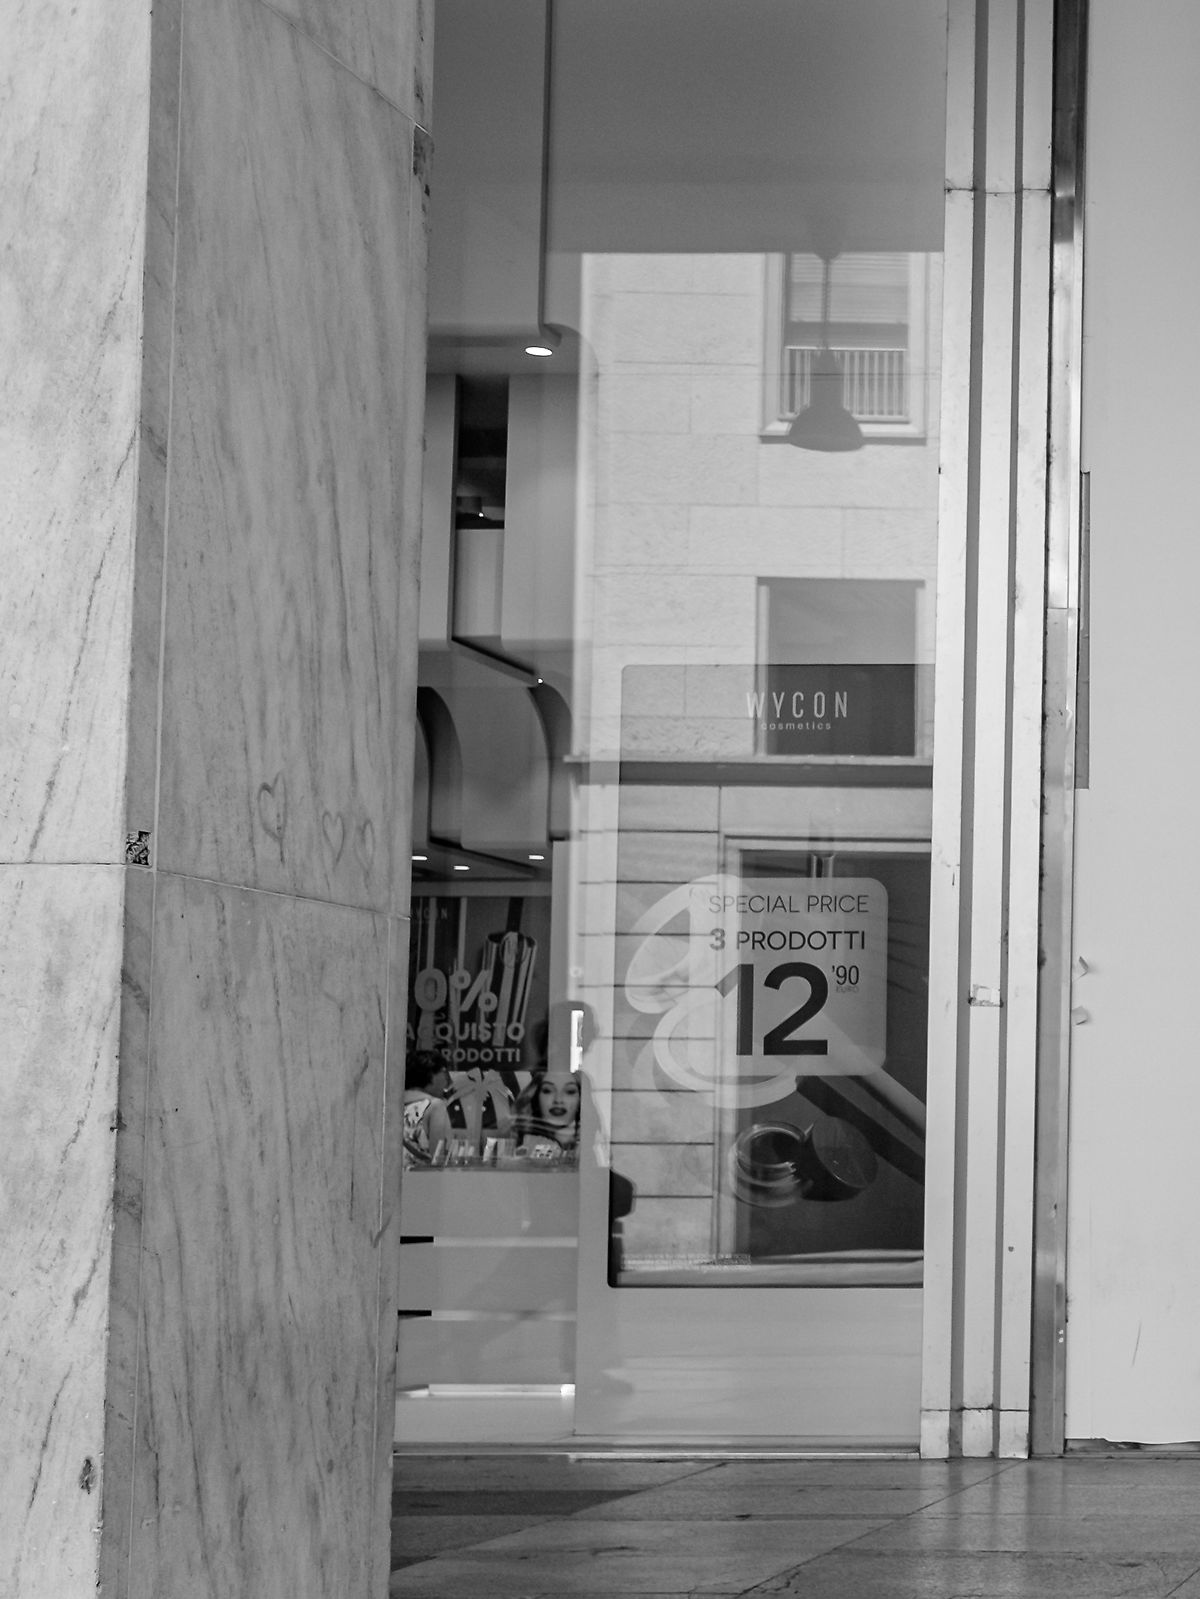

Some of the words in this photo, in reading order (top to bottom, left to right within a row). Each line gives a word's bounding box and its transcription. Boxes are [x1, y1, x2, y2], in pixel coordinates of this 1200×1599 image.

[746, 691, 847, 718] WYCON
[761, 721, 831, 730] cosmetics
[709, 895, 800, 913] SPECIAL
[807, 895, 870, 913] PRICE
[709, 928, 726, 951] 3
[736, 930, 866, 950] PRODOTTI
[714, 962, 828, 1056] 12
